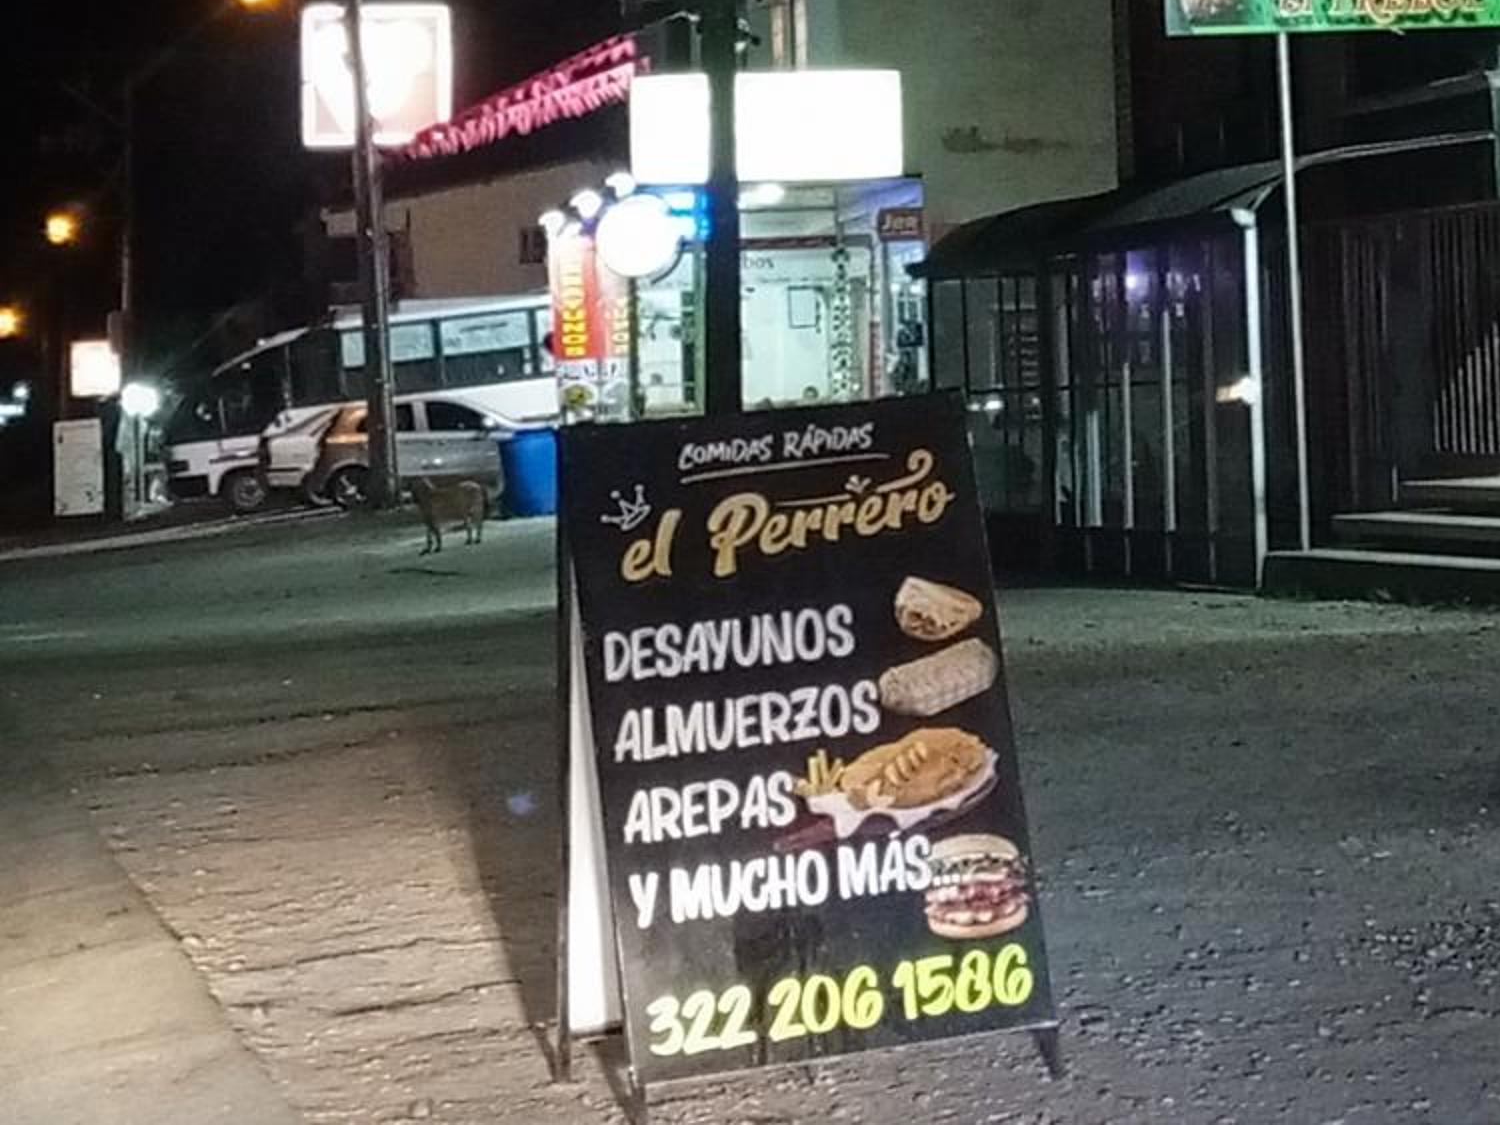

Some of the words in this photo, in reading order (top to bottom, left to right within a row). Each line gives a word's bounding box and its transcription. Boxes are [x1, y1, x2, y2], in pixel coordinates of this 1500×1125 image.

[679, 432, 771, 471] COMIDAS
[783, 424, 875, 457] RÁPIDAS
[622, 509, 680, 581] el
[708, 450, 957, 576] Perrero
[604, 604, 854, 681] DESAYUNOS
[614, 680, 880, 762] ALMUERZOS
[623, 772, 797, 843] AREPAS
[630, 872, 662, 929] Y
[670, 848, 828, 925] MUCHO
[647, 984, 761, 1056] 322
[768, 965, 885, 1036] 206
[895, 943, 1033, 1020] 1586
